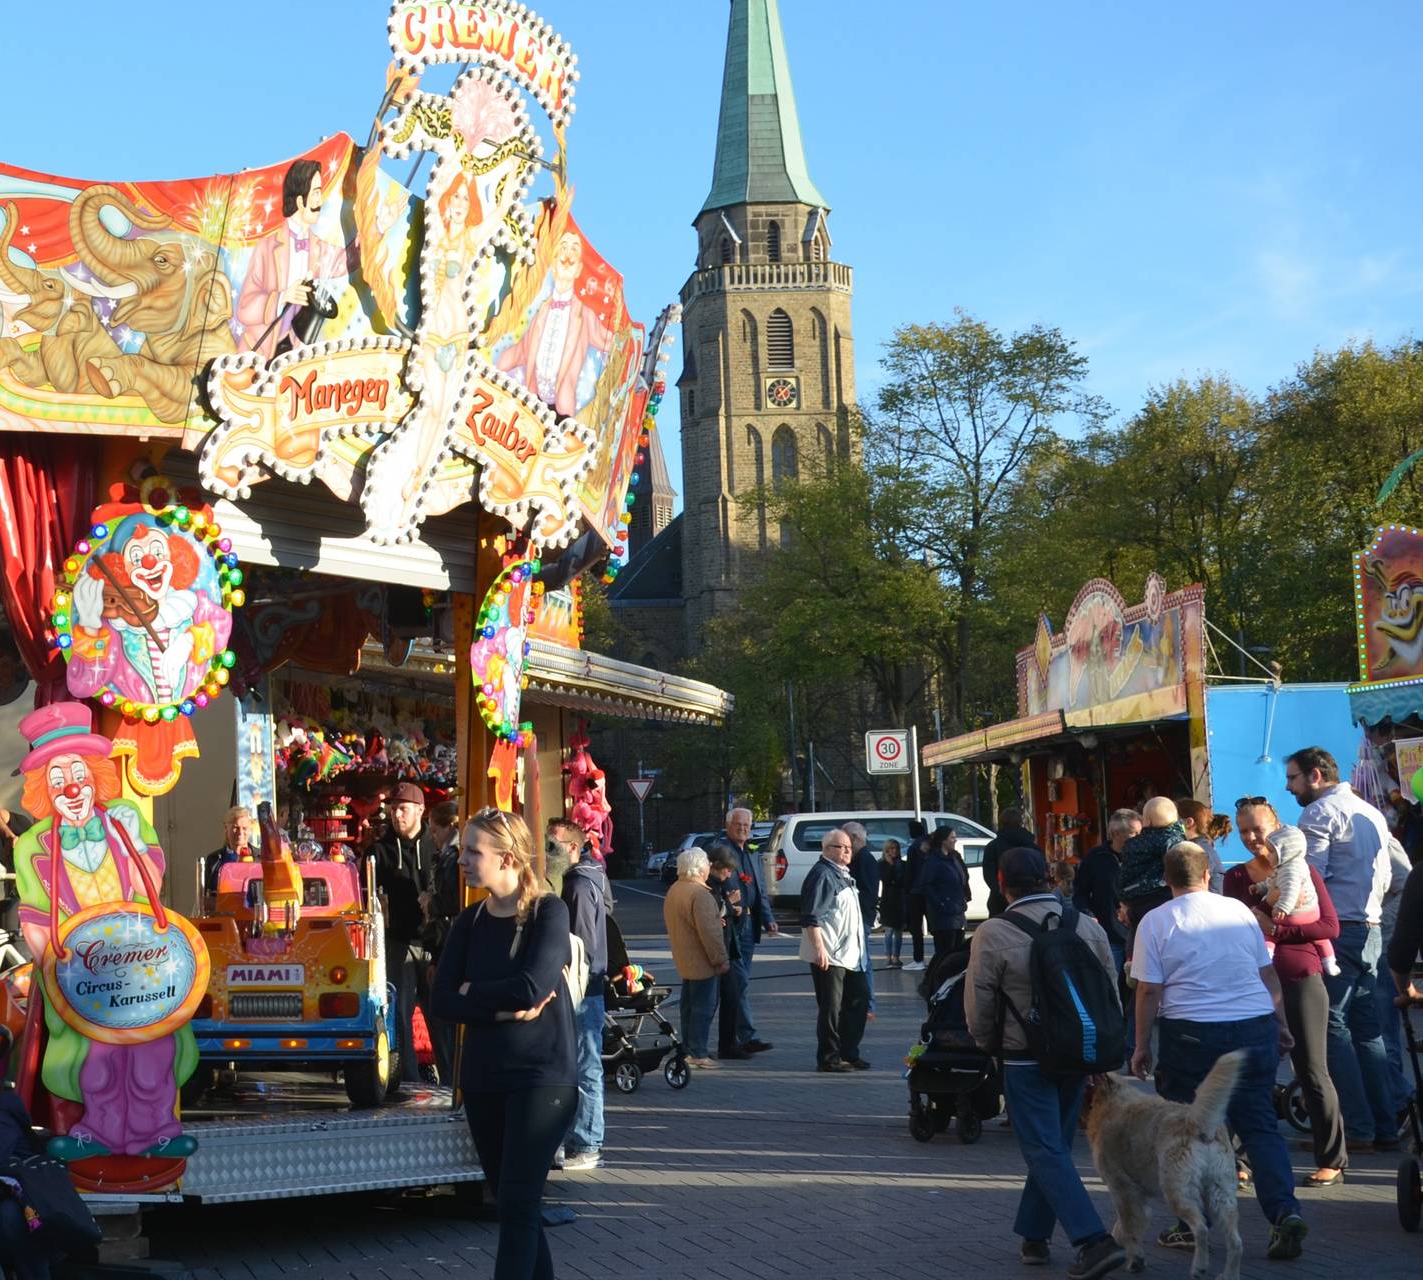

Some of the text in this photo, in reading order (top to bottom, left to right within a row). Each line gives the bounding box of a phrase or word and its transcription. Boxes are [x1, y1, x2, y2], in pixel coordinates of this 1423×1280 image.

[400, 1, 566, 111] CREMER
[279, 369, 389, 421] Manegen
[465, 387, 537, 463] Zauber
[881, 743, 896, 754] 30
[231, 968, 290, 982] MIAMI
[109, 985, 177, 1008] Karussell
